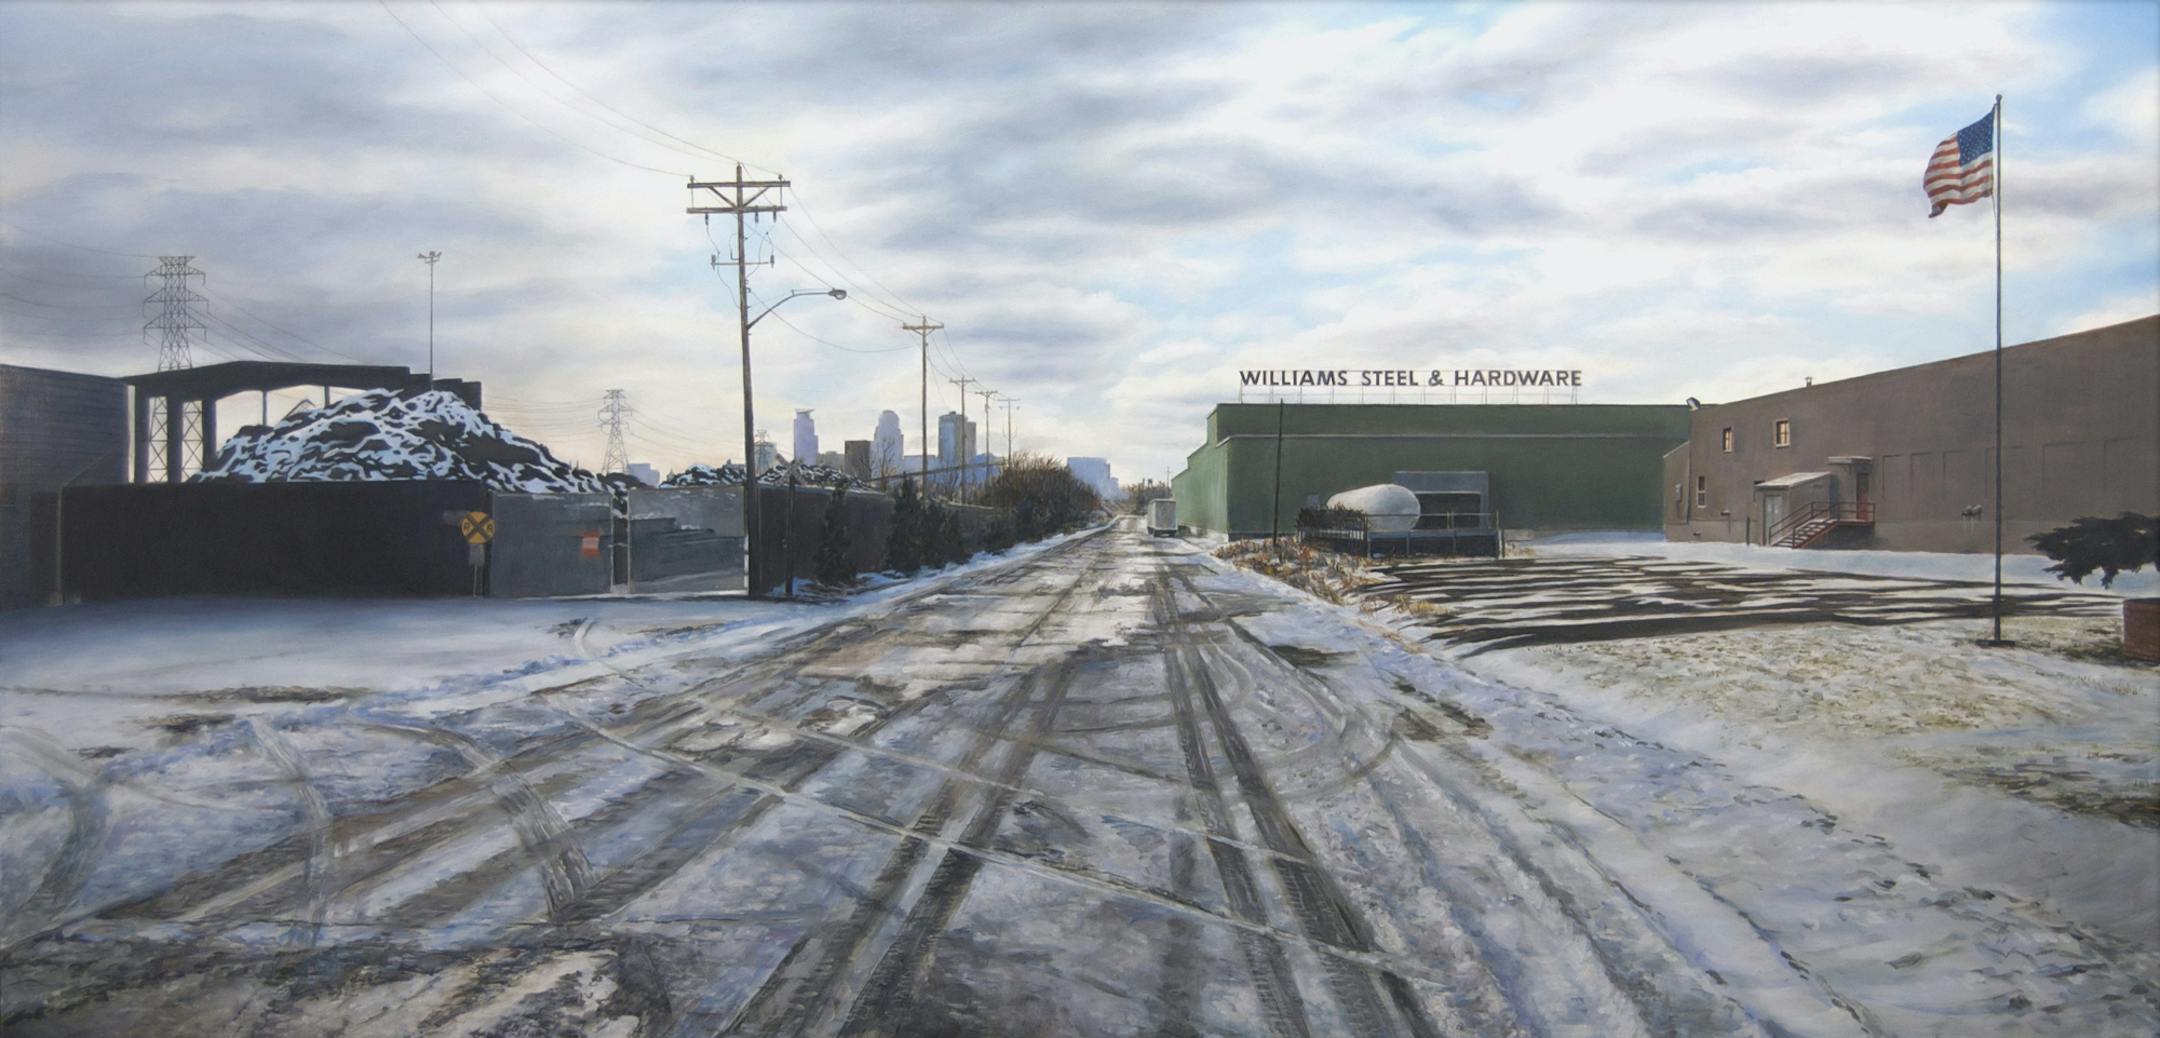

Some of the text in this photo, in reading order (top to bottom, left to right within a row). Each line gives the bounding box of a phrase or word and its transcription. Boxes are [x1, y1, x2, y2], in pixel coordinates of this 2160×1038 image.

[1239, 370, 1581, 386] WILLIAMS STEEL & HARDWARE
